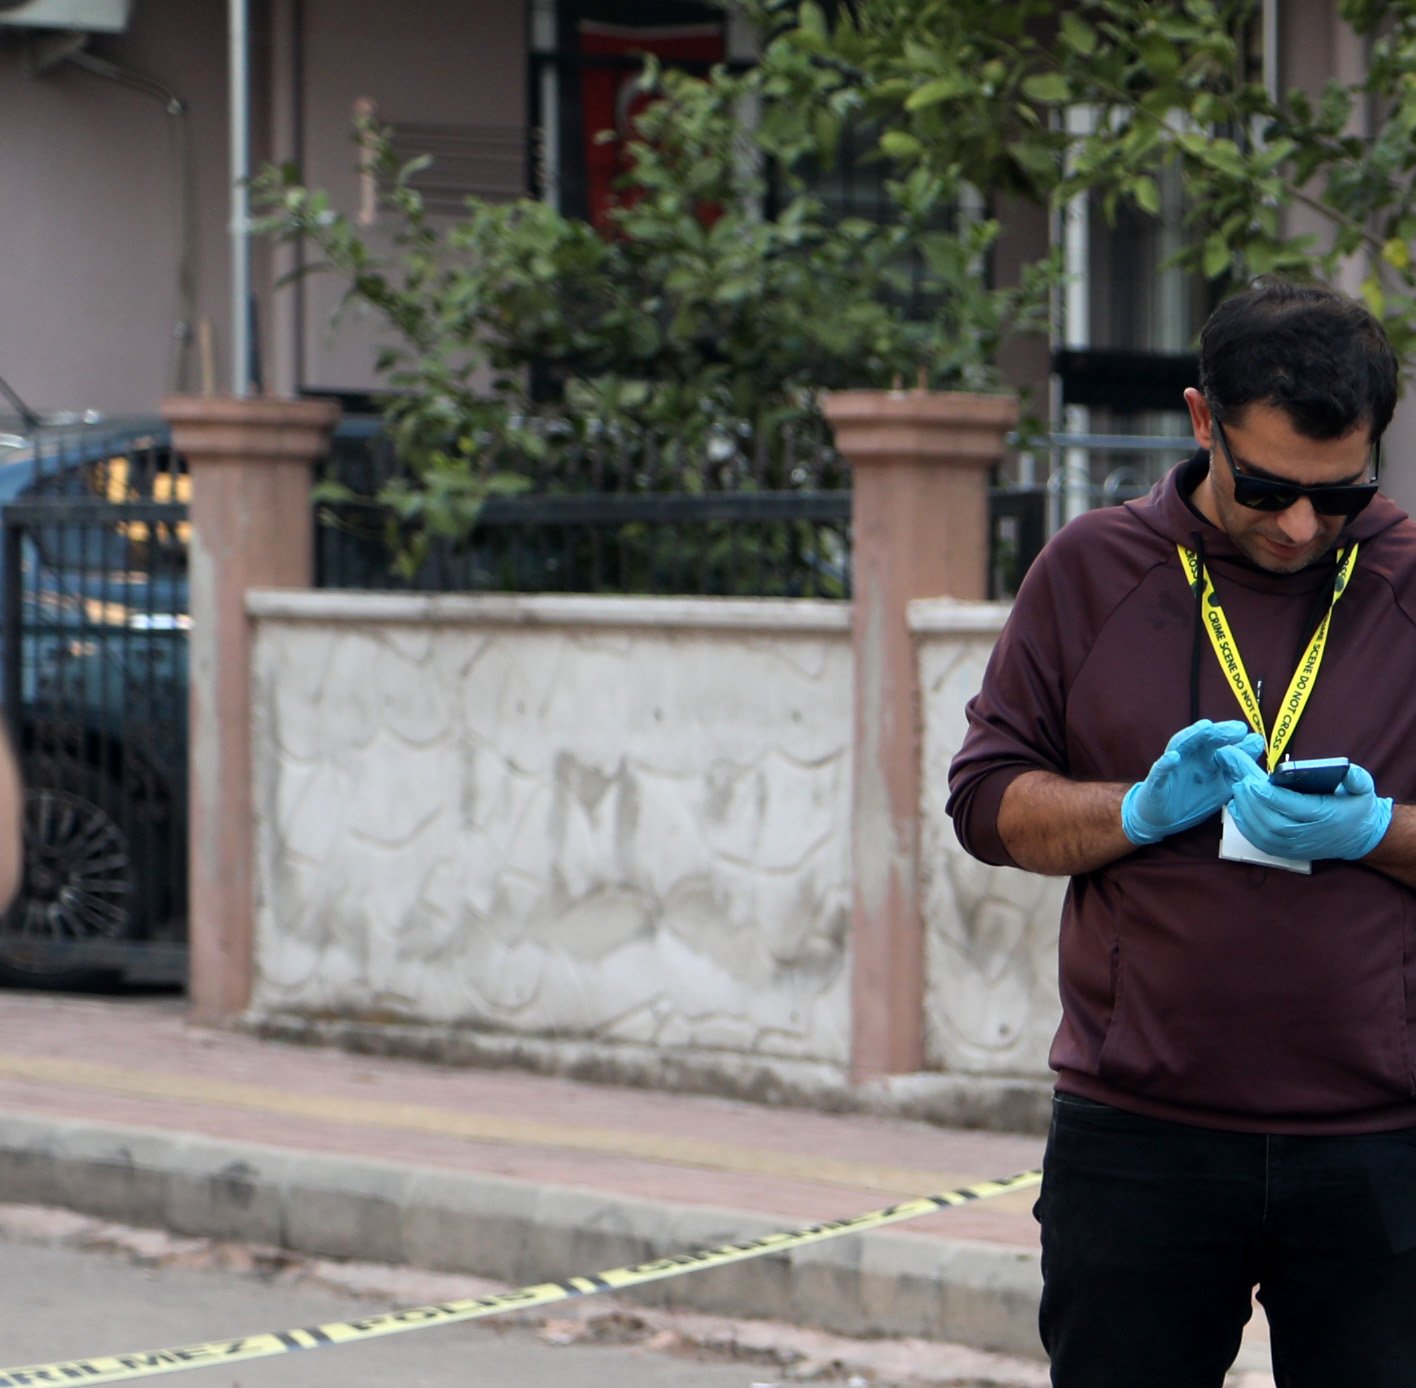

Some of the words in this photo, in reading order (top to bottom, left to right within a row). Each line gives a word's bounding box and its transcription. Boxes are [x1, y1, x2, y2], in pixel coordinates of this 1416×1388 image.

[1208, 610, 1227, 642] CRIME
[1219, 641, 1238, 673] SCENE
[1232, 672, 1245, 690] DO
[1241, 689, 1256, 712] NOT
[1303, 643, 1321, 674] SCENE
[1296, 675, 1309, 690] DO
[1287, 690, 1303, 715] NOT
[1272, 714, 1292, 751] CROSS
